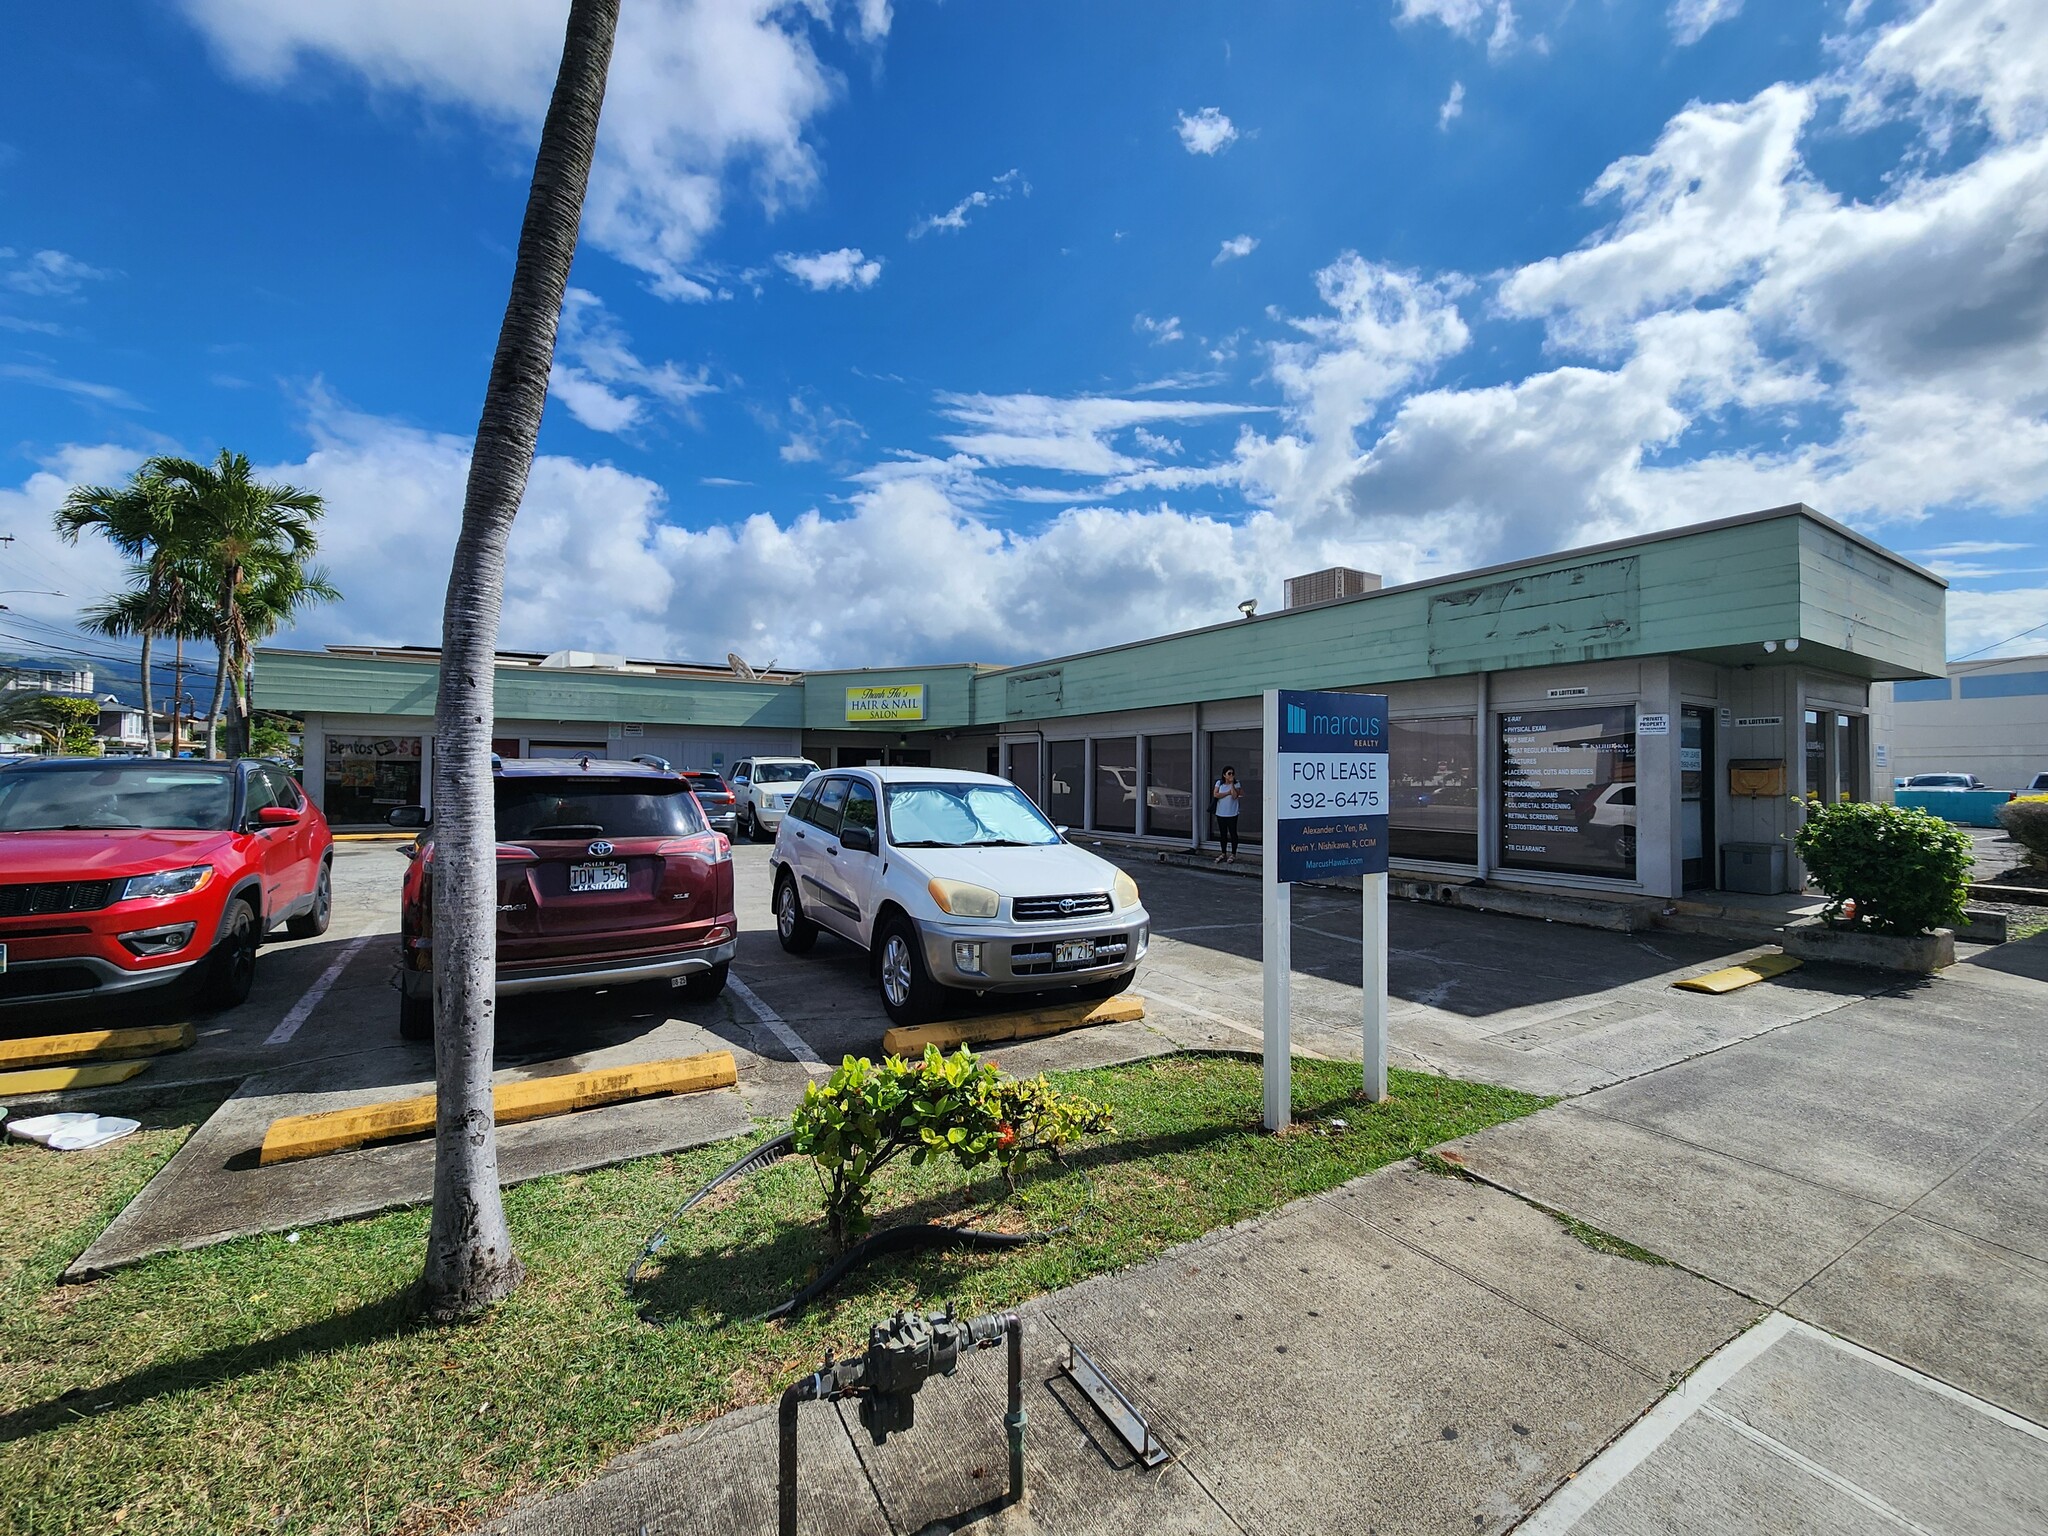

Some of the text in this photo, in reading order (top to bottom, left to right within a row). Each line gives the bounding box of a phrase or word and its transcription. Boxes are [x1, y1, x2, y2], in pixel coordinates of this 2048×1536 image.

[1559, 688, 1585, 696] LOITERING
[851, 698, 918, 710] HAIR & NAIL
[869, 710, 898, 719] SALON
[1313, 715, 1380, 736] marcus
[328, 740, 374, 755] Bentos
[1293, 762, 1377, 780] FOR LEASE
[1290, 791, 1379, 809] 392-6475
[1302, 823, 1368, 835] Alexander C. Yen, RA
[1291, 843, 1309, 853] Kevin
[1310, 843, 1317, 851] Y.
[1318, 841, 1351, 851] Nishikawa,
[1360, 839, 1377, 847] CCIM
[1306, 857, 1363, 869] MarcusHawaii.com
[603, 867, 626, 882] 556
[1078, 944, 1093, 958] 215
